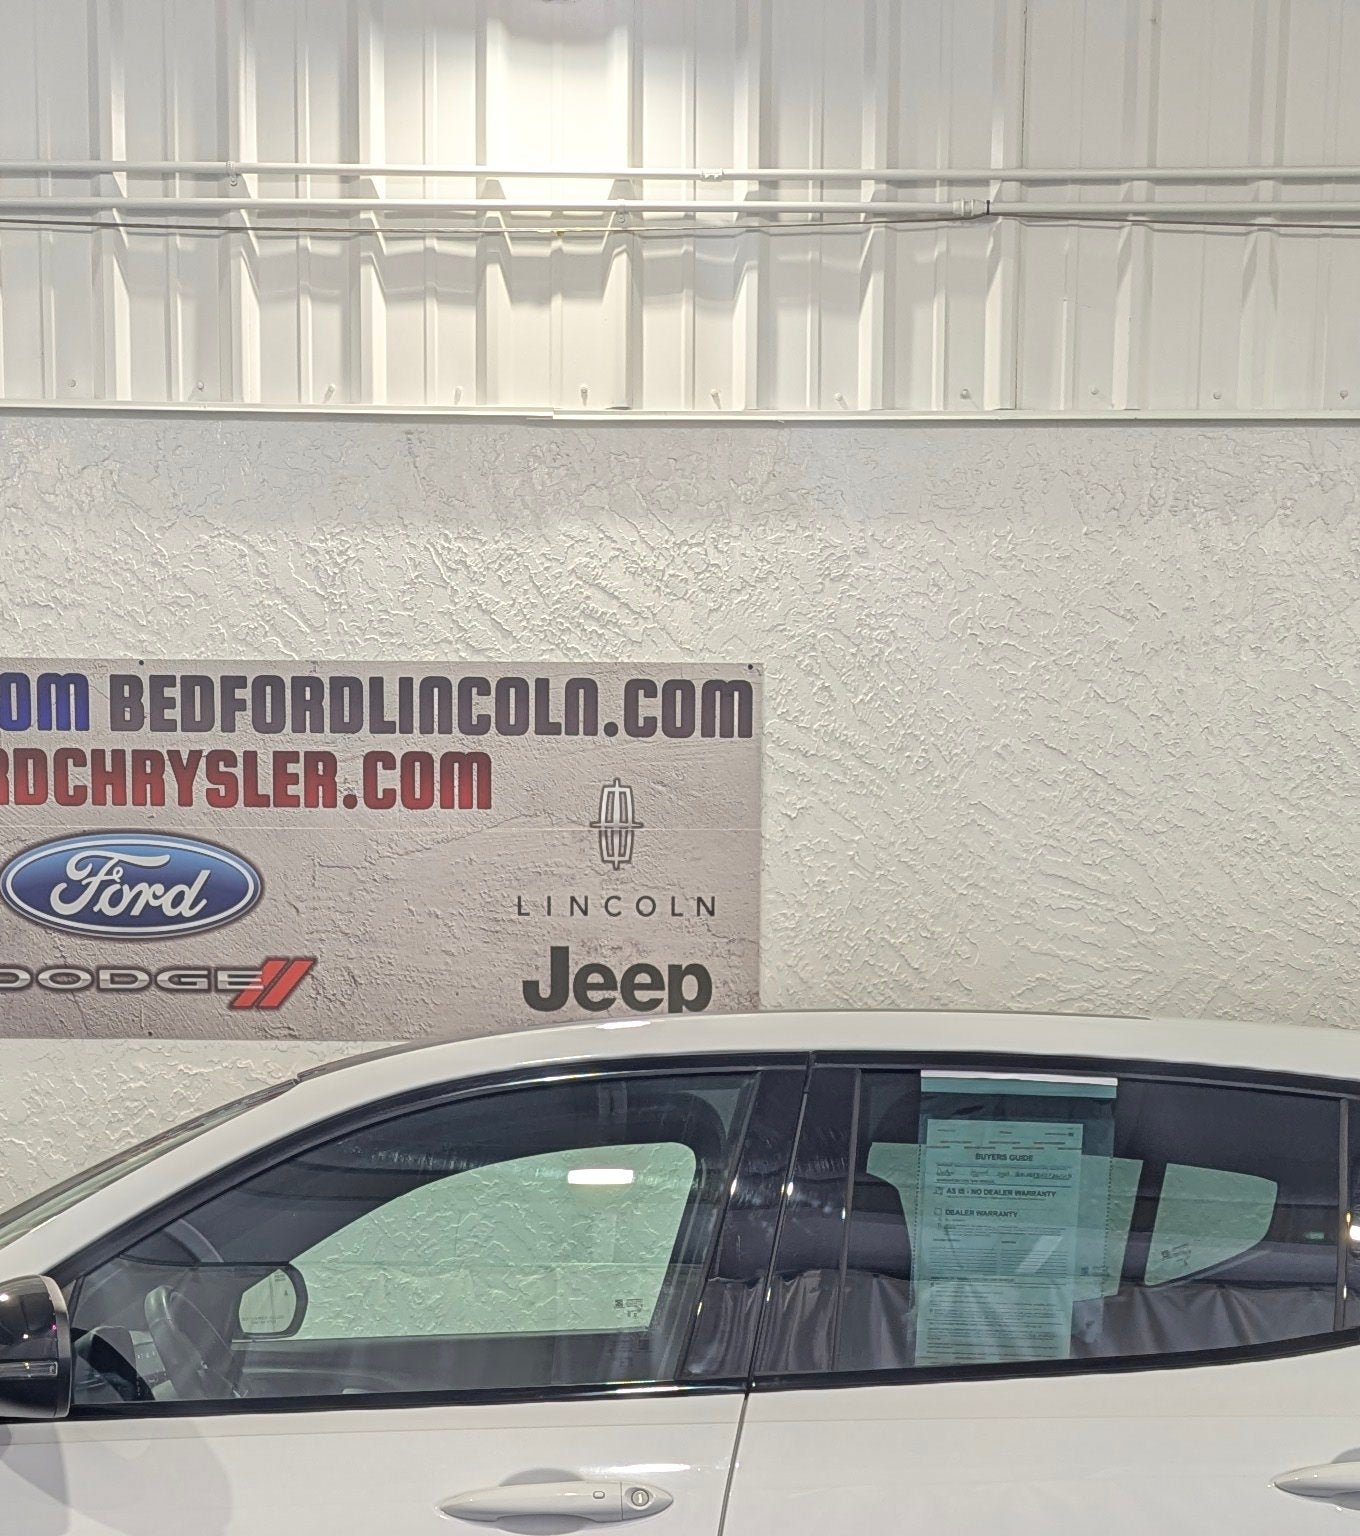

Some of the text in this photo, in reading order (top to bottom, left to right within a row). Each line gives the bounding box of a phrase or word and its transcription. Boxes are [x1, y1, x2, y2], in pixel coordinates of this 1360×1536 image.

[109, 674, 754, 739] BEDFORDLINCOLN.COM
[49, 850, 212, 918] Ford
[517, 895, 716, 918] LINCOLN
[522, 945, 714, 1014] Jeep
